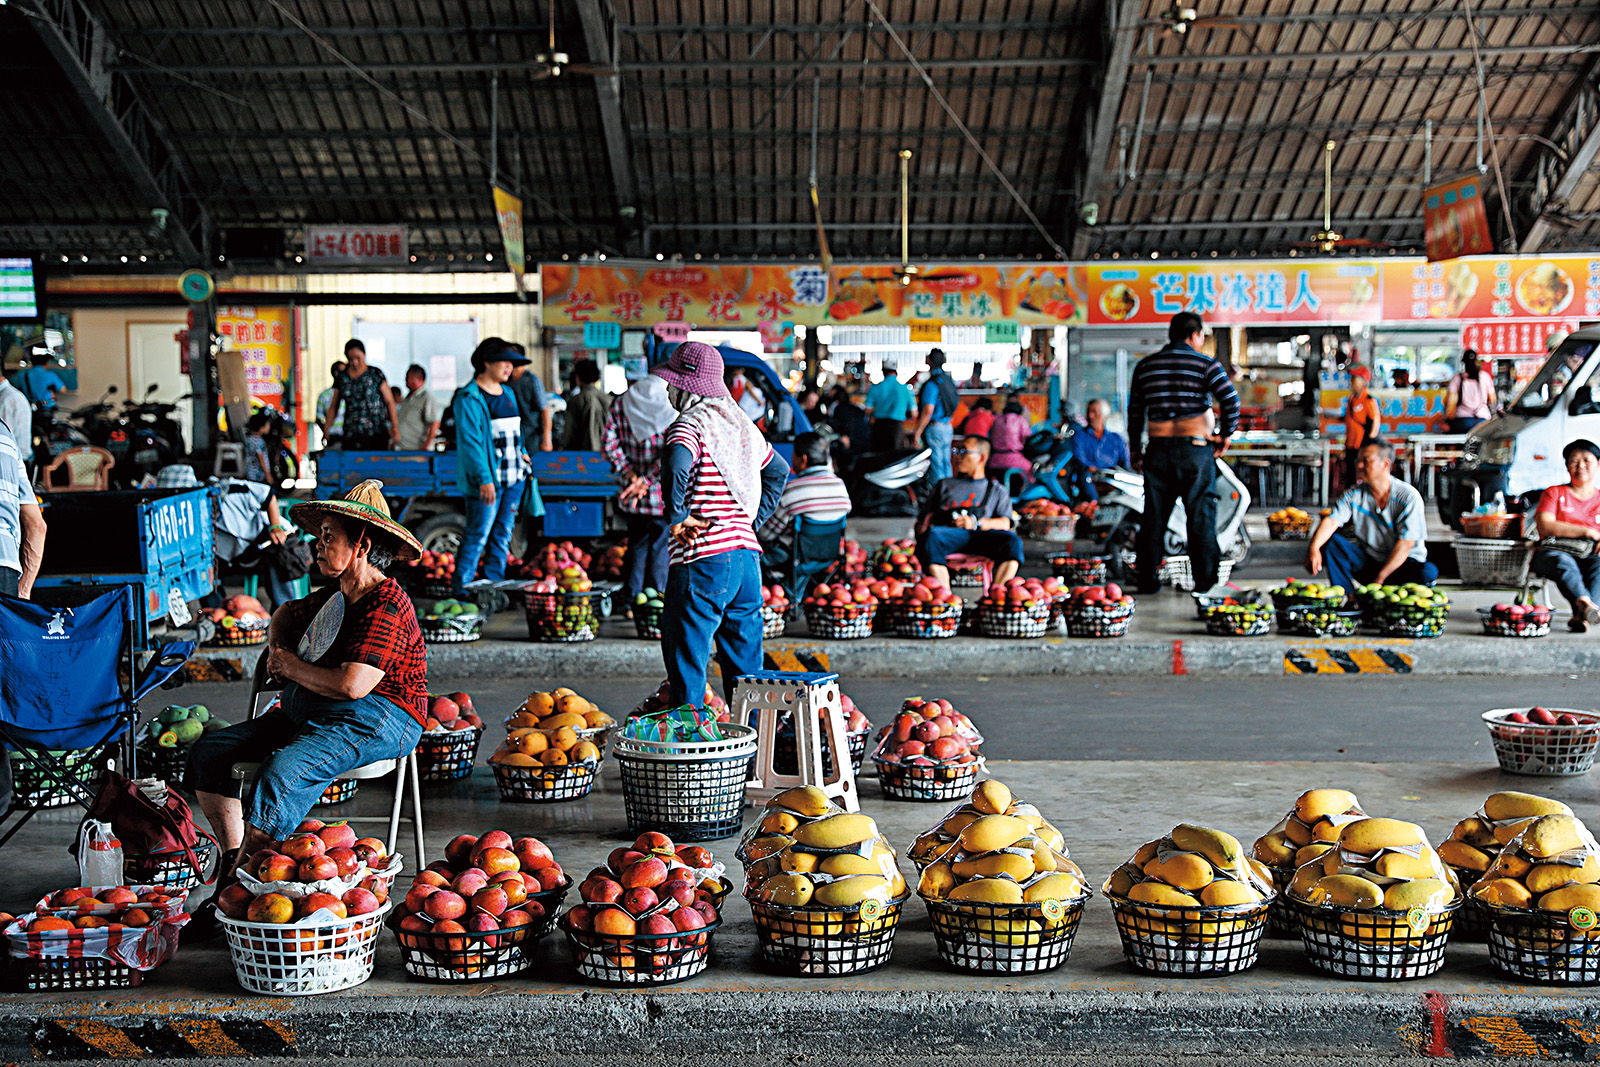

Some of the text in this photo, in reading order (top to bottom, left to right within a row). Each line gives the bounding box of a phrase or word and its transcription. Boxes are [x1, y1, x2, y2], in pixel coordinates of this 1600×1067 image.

[791, 267, 830, 306] 菊
[1150, 268, 1322, 315] 芒果冰達人
[564, 289, 793, 322] 芒果雪花冰
[910, 291, 994, 319] 芒果冰
